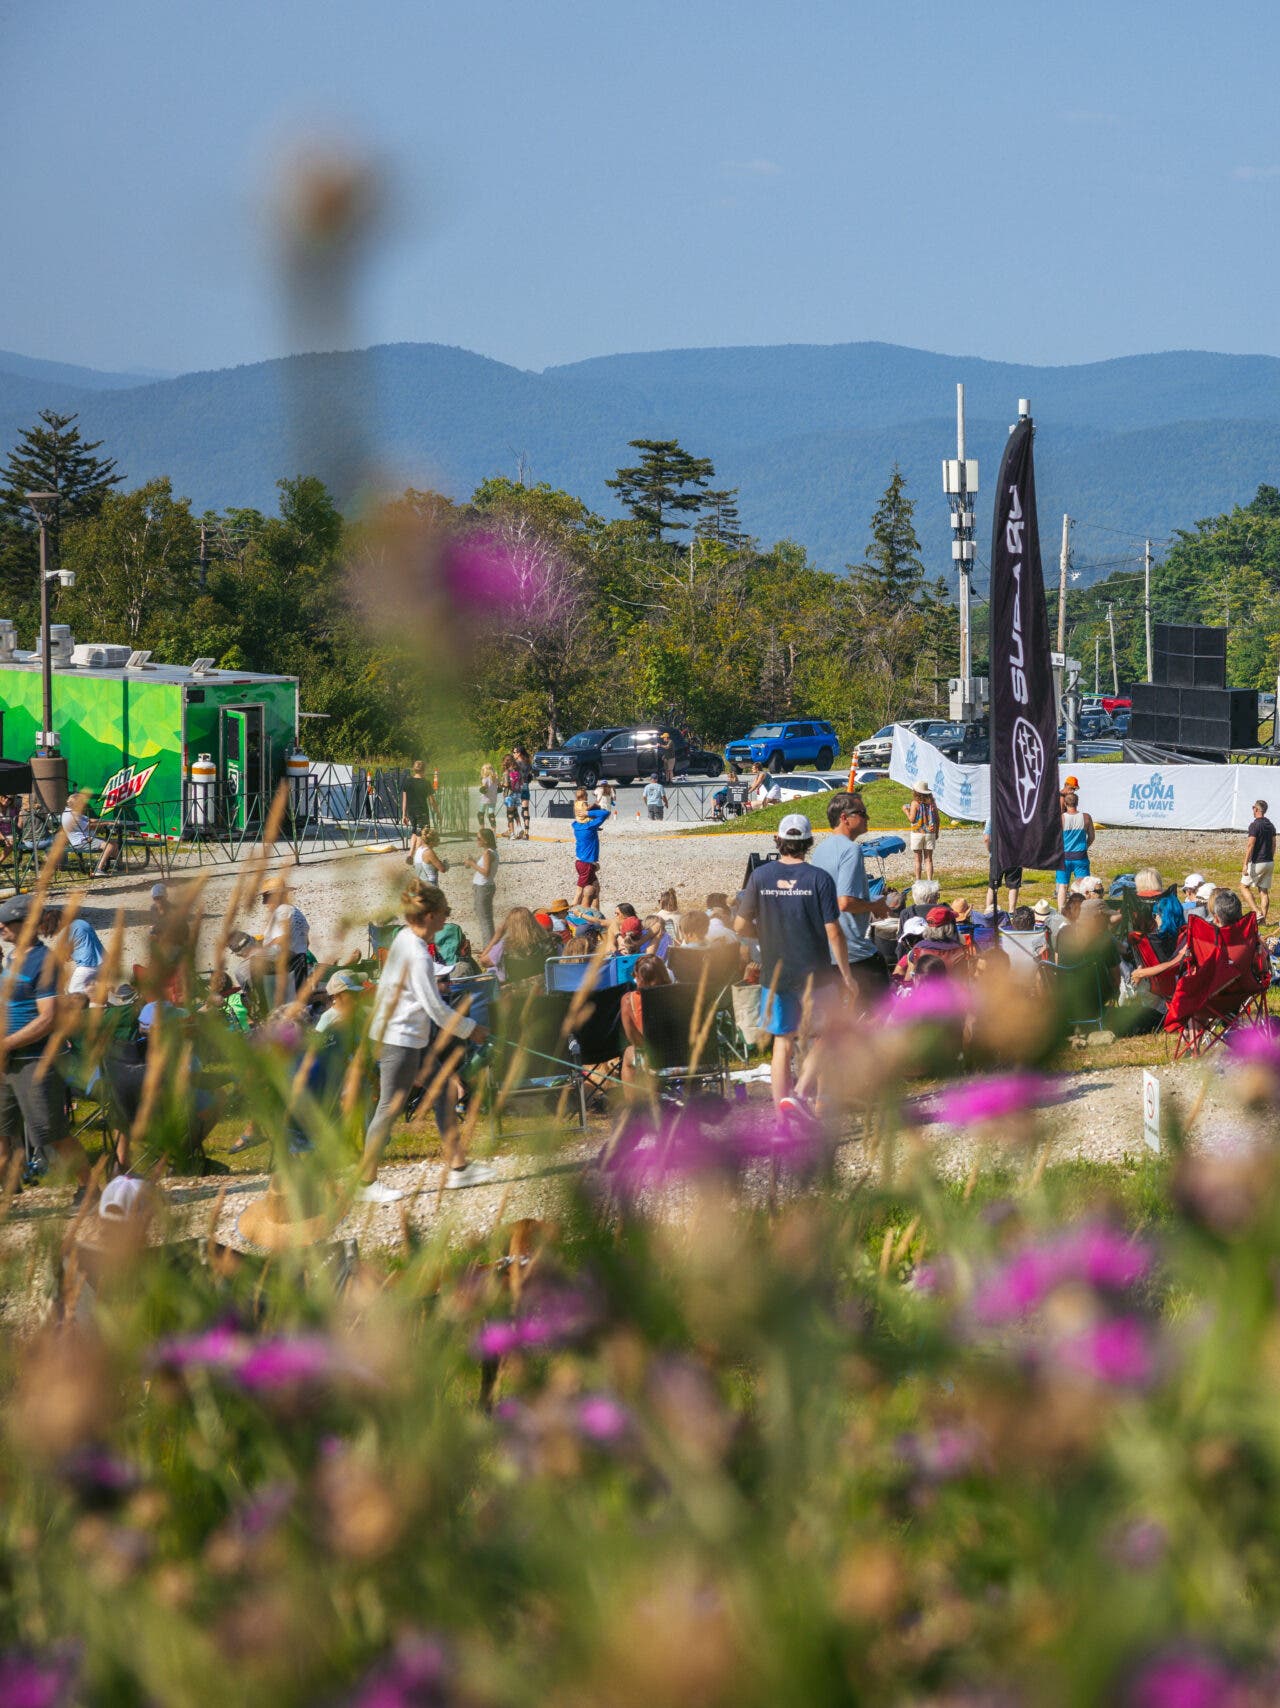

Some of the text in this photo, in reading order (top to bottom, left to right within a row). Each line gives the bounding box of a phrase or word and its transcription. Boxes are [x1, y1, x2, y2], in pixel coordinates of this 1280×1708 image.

[1131, 783, 1174, 800] KONA
[1129, 800, 1174, 810] BIG WAVE
